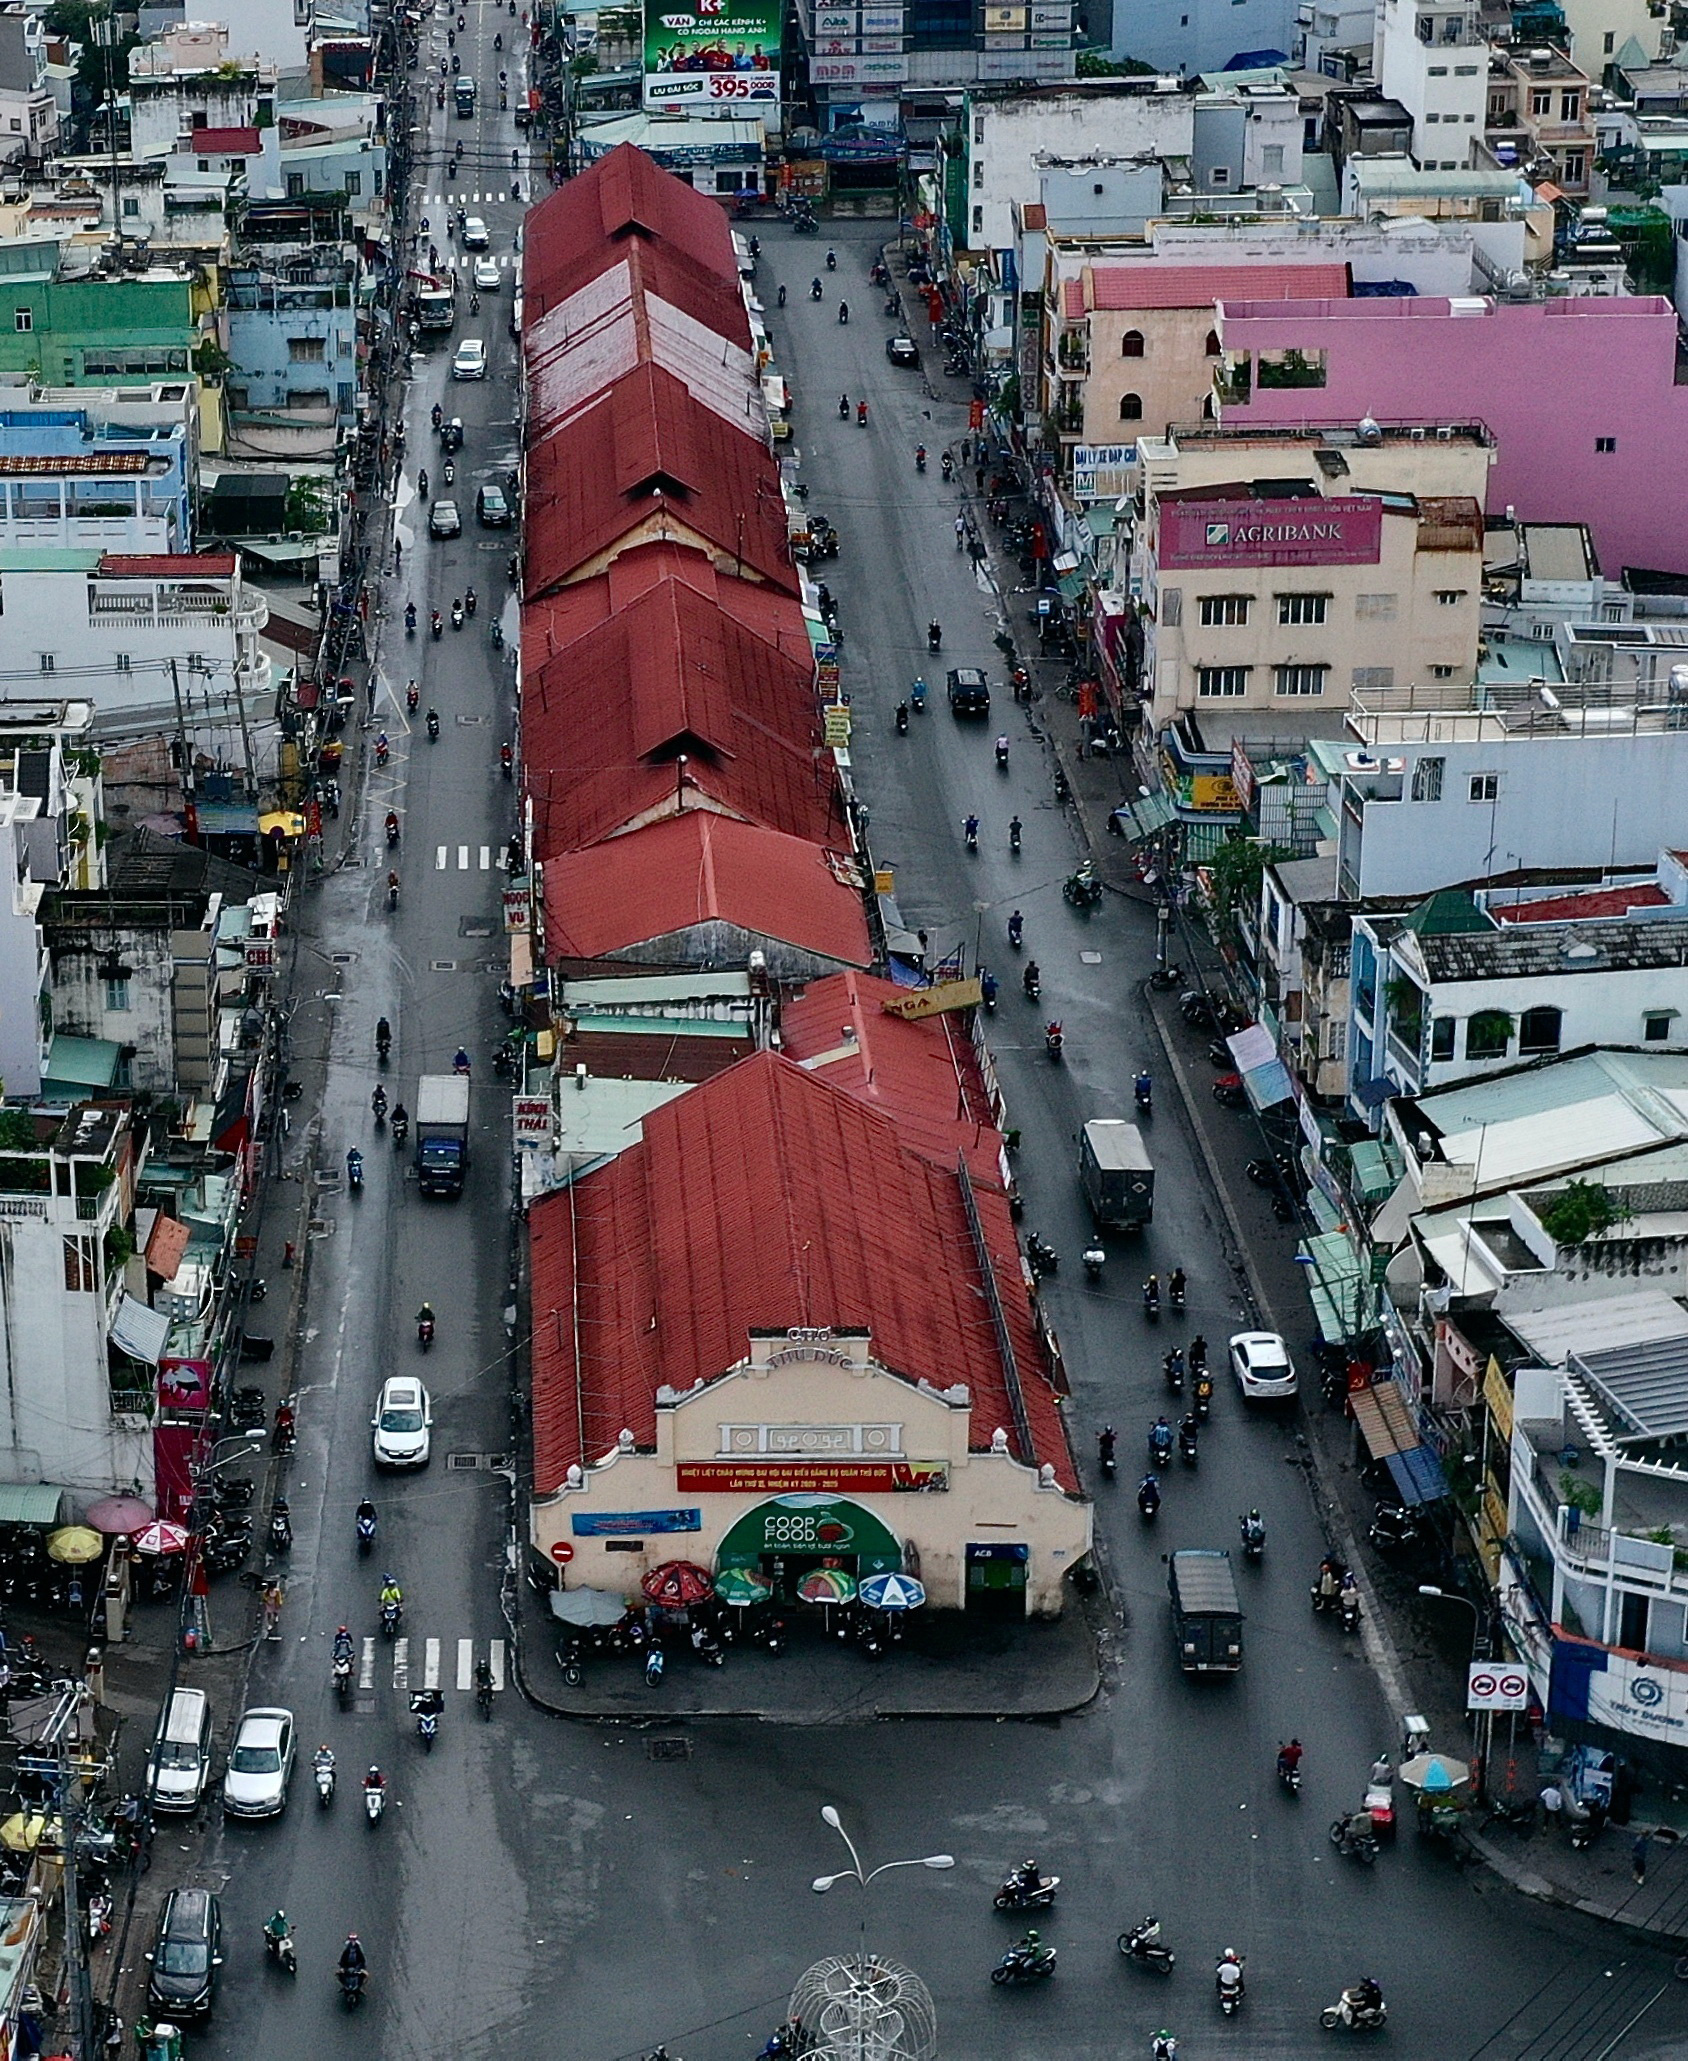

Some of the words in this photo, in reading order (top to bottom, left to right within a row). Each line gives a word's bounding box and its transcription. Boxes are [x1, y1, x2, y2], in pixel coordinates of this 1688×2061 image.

[700, 0, 726, 12] K+
[709, 79, 749, 98] 395
[1234, 524, 1342, 542] AGRIBANK
